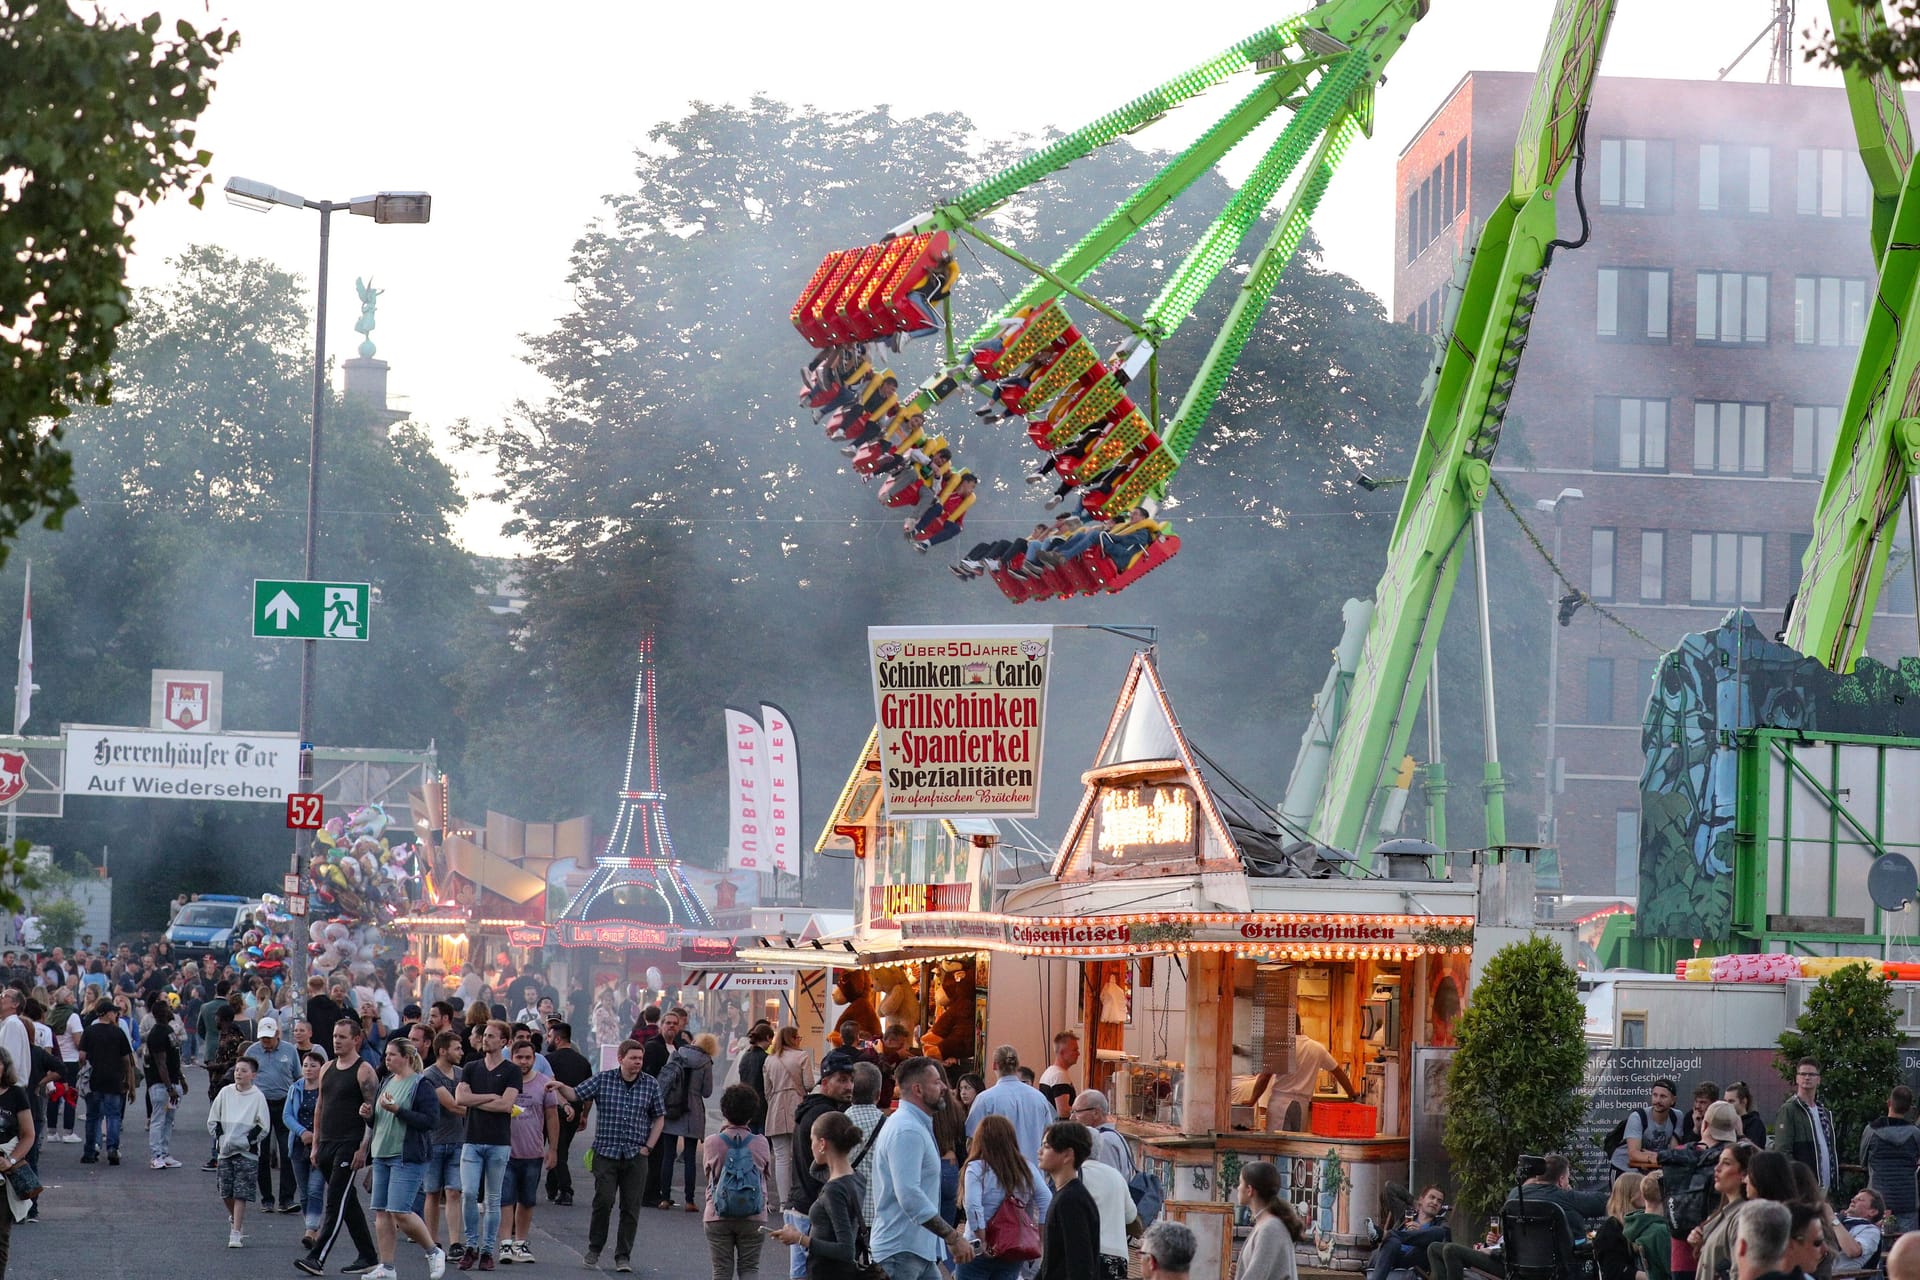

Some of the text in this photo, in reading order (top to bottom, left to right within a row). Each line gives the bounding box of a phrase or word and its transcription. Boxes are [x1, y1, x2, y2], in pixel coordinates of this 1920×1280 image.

[904, 642, 1018, 657] ÜBER 50 JAHRE
[879, 659, 1042, 688] Schinken Carlo
[881, 691, 1038, 729] Grillschinken
[234, 742, 278, 768] Tor
[88, 775, 282, 799] Auf Wiedersehen
[889, 766, 1033, 790] Spezialitäten
[890, 788, 1031, 808] im ofenfrischen Brötchen
[291, 796, 320, 826] 52
[1012, 924, 1131, 945] Ochsenfleisch
[1240, 923, 1395, 942] Grillschinken
[735, 978, 789, 986] POFFERTJES
[1619, 1056, 1702, 1072] Schnitzeljagd!
[1631, 1073, 1682, 1082] Geschichte?
[1595, 1100, 1615, 1109] alles
[1616, 1100, 1649, 1110] begann
